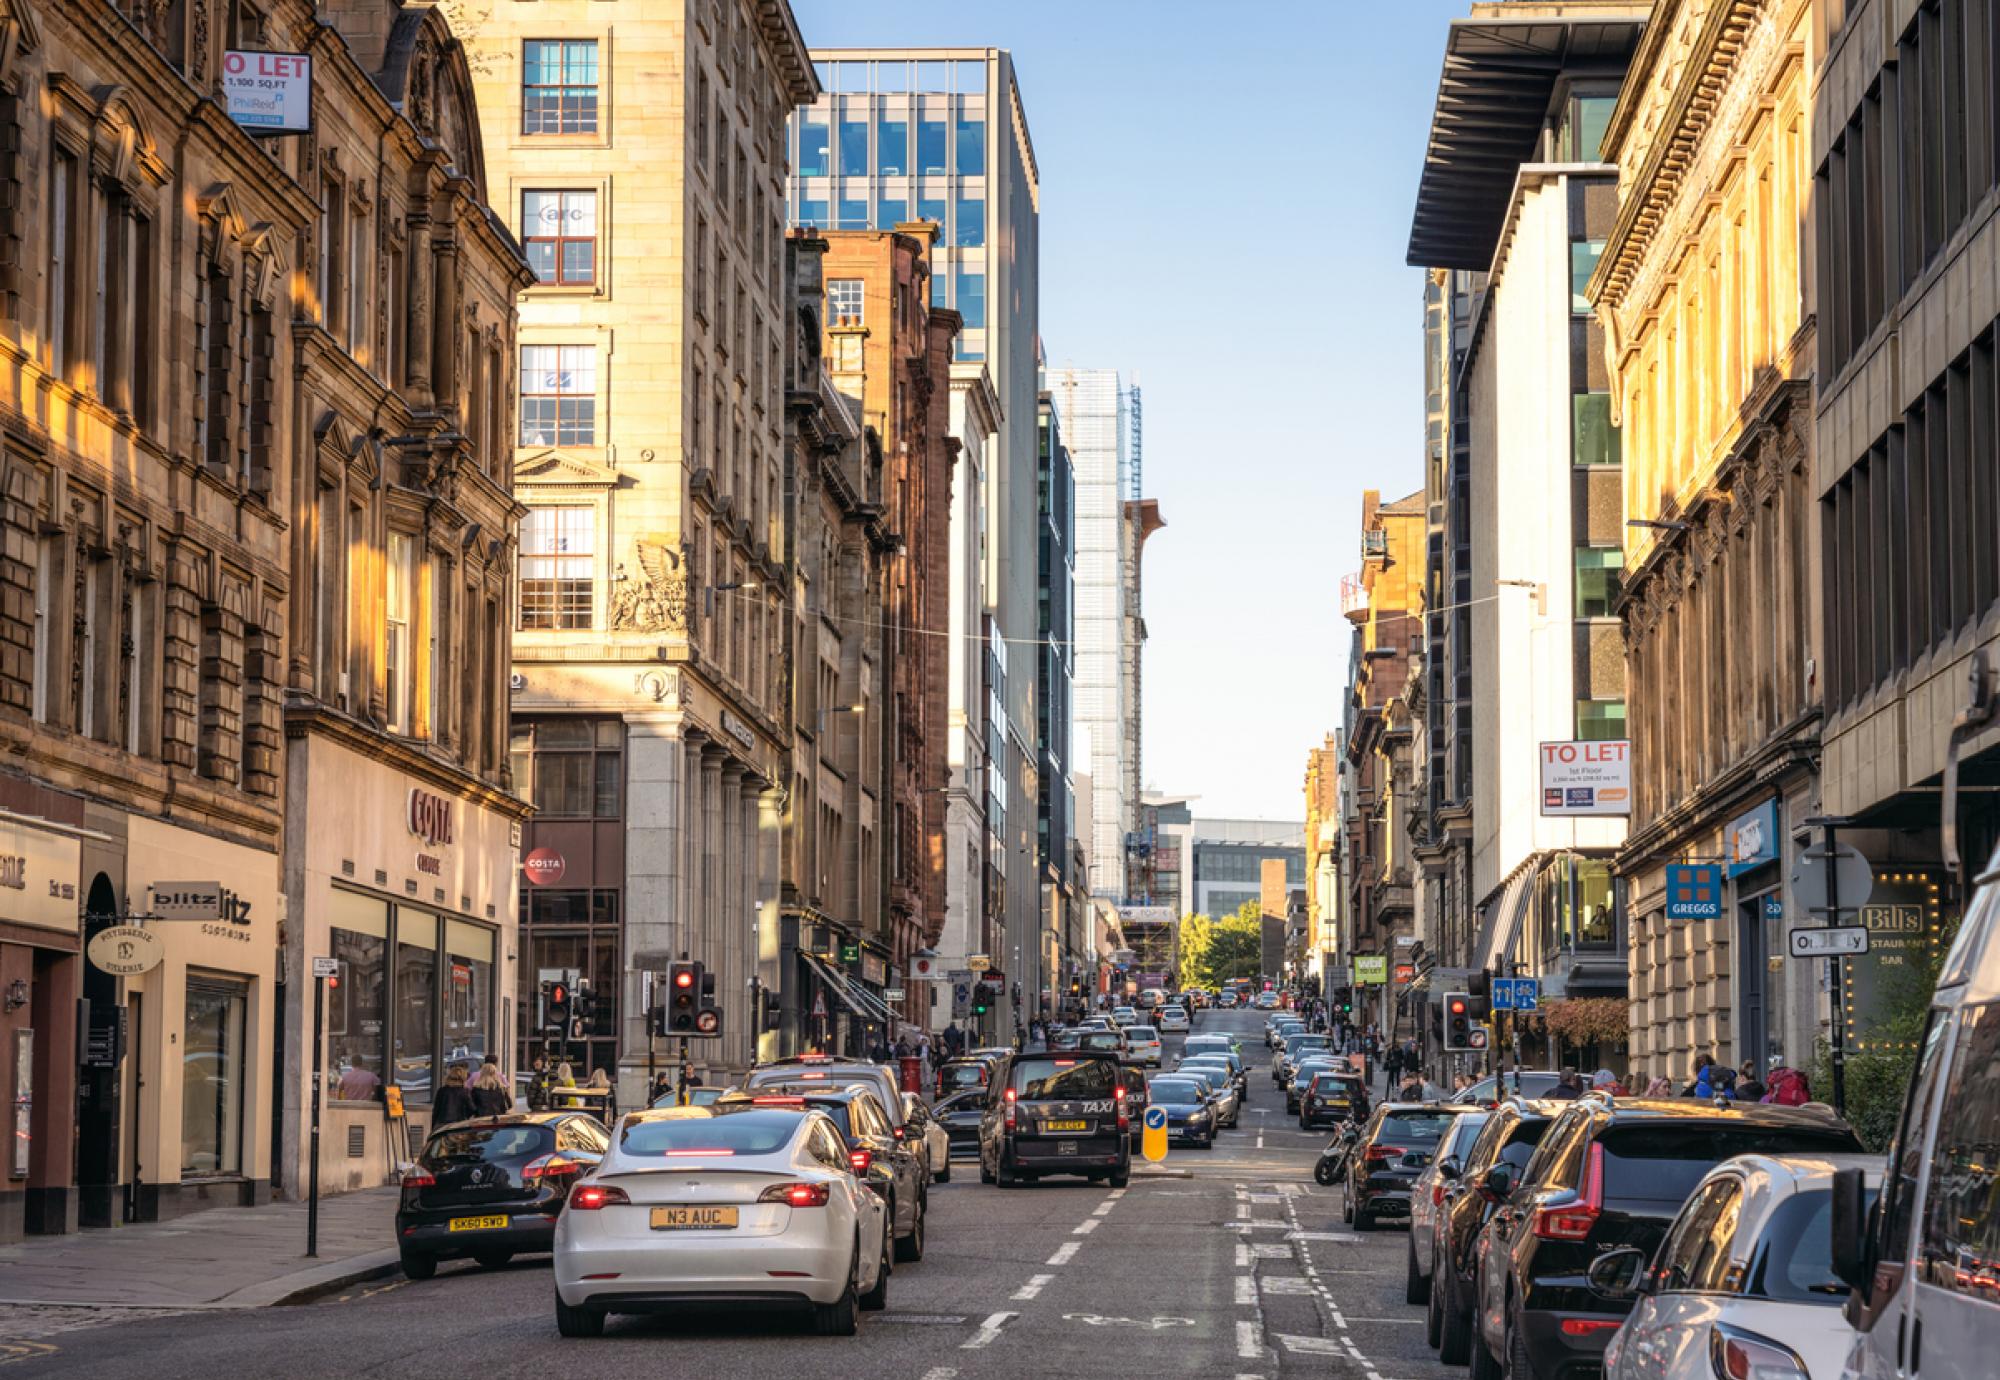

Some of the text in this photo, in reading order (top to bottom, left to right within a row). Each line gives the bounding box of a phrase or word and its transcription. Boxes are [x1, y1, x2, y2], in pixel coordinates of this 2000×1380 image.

[258, 55, 306, 79] LET
[1543, 743, 1628, 764] TO LET
[406, 788, 453, 847] COSTA
[528, 858, 561, 868] COSTA
[154, 893, 217, 905] blitz
[219, 888, 252, 925] litz
[1672, 903, 1717, 914] GREGGS
[1867, 905, 1918, 929] Bill's
[1081, 1101, 1115, 1113] TAXI
[667, 1209, 722, 1224] N3 AUC
